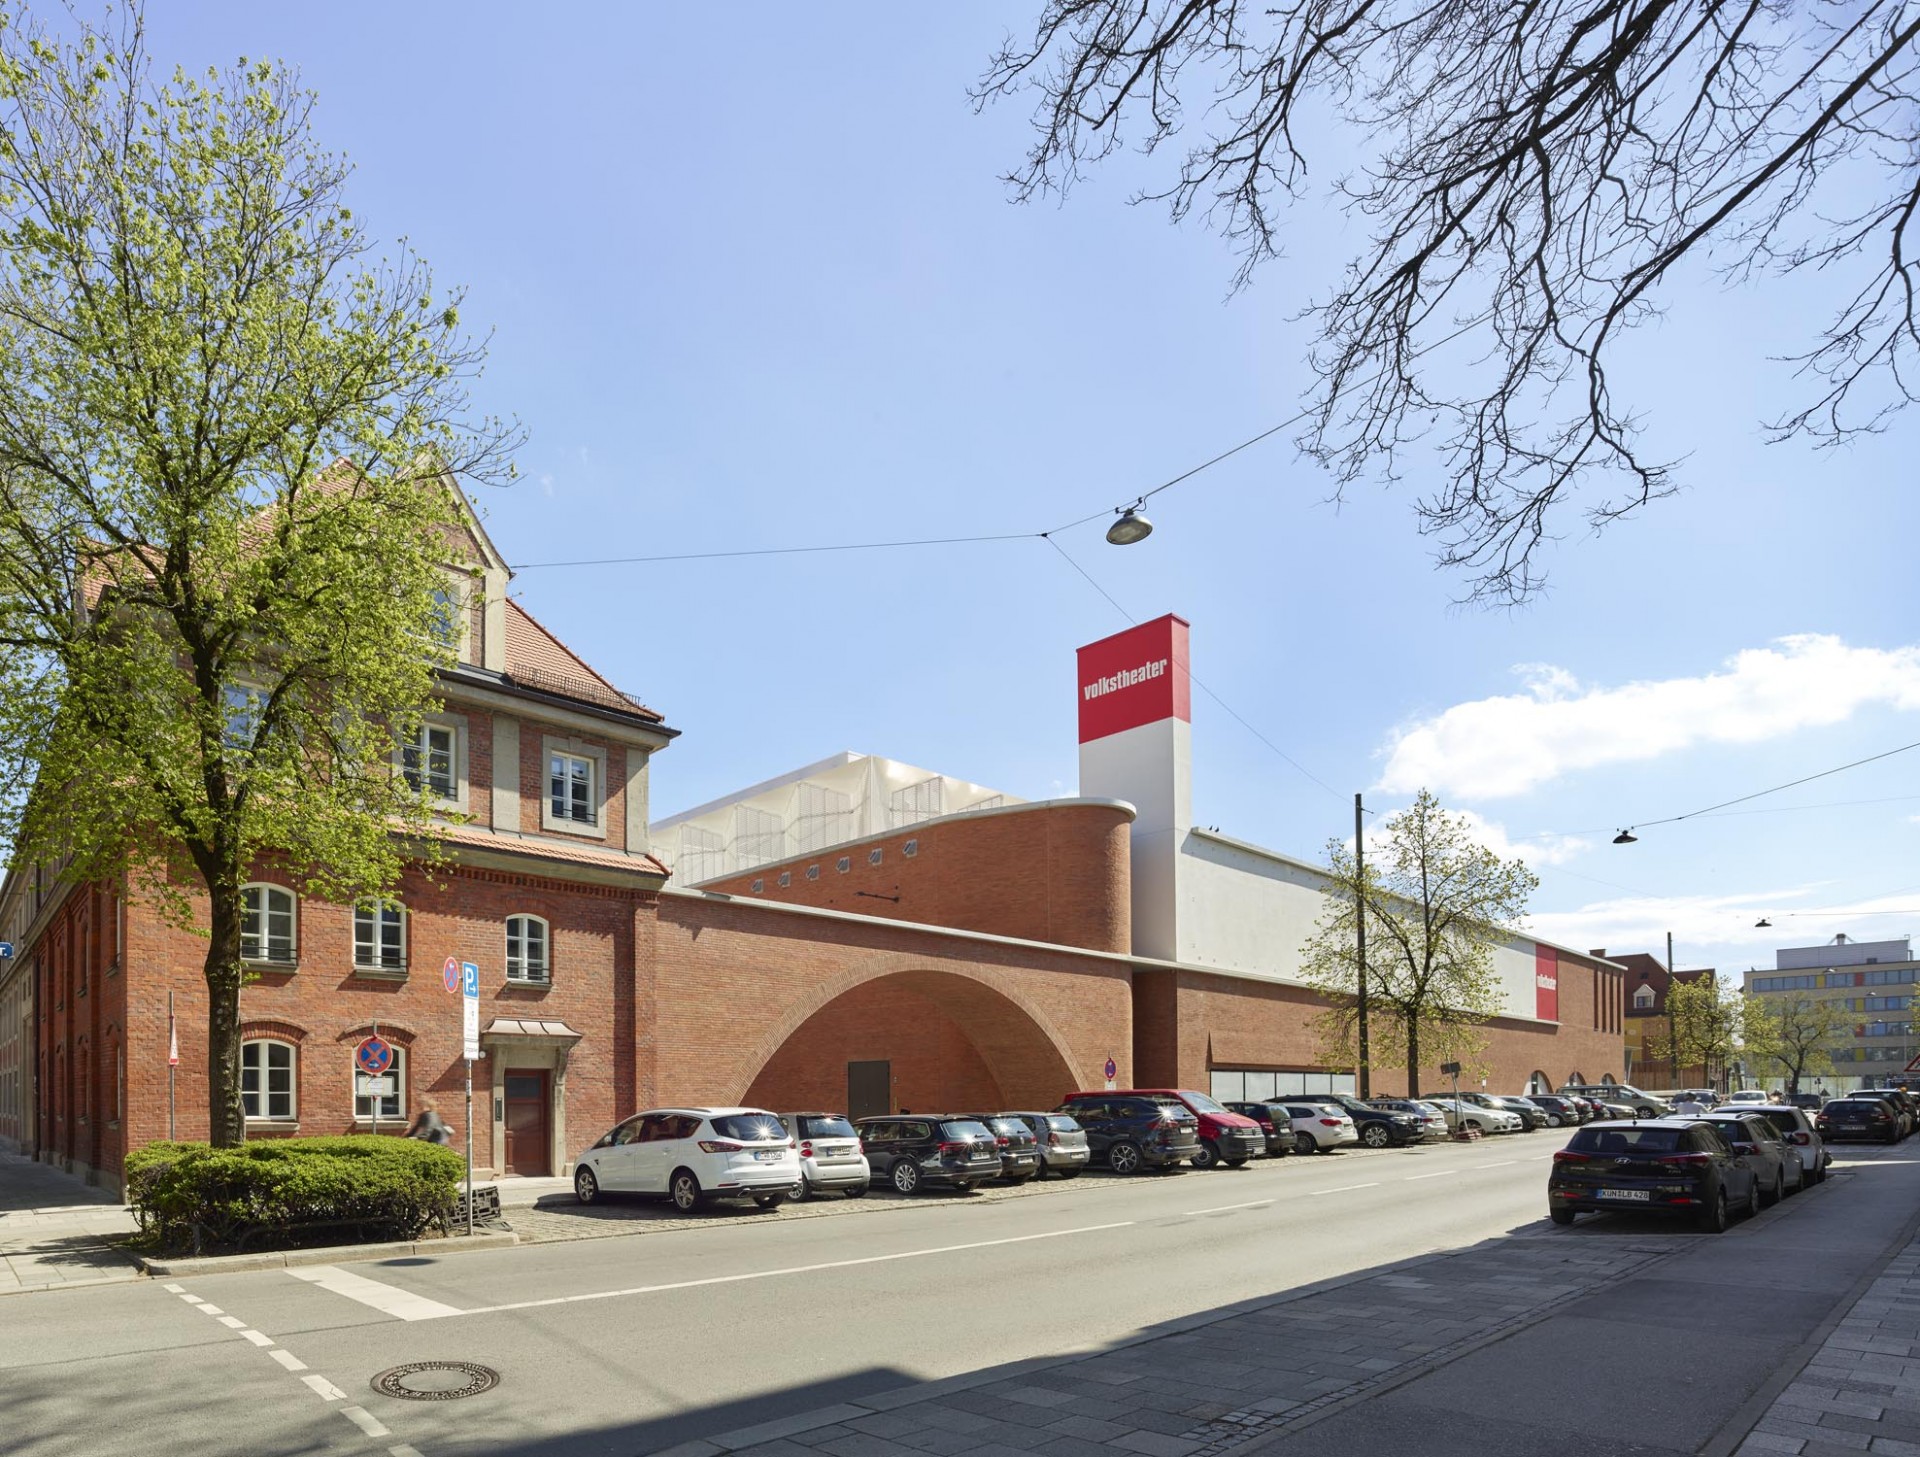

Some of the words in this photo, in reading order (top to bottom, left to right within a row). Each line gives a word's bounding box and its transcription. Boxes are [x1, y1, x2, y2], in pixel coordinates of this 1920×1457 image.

[1084, 659, 1167, 700] volkstheater
[465, 967, 474, 992] P
[1602, 1190, 1617, 1198] KUN
[1634, 1191, 1648, 1199] 428
